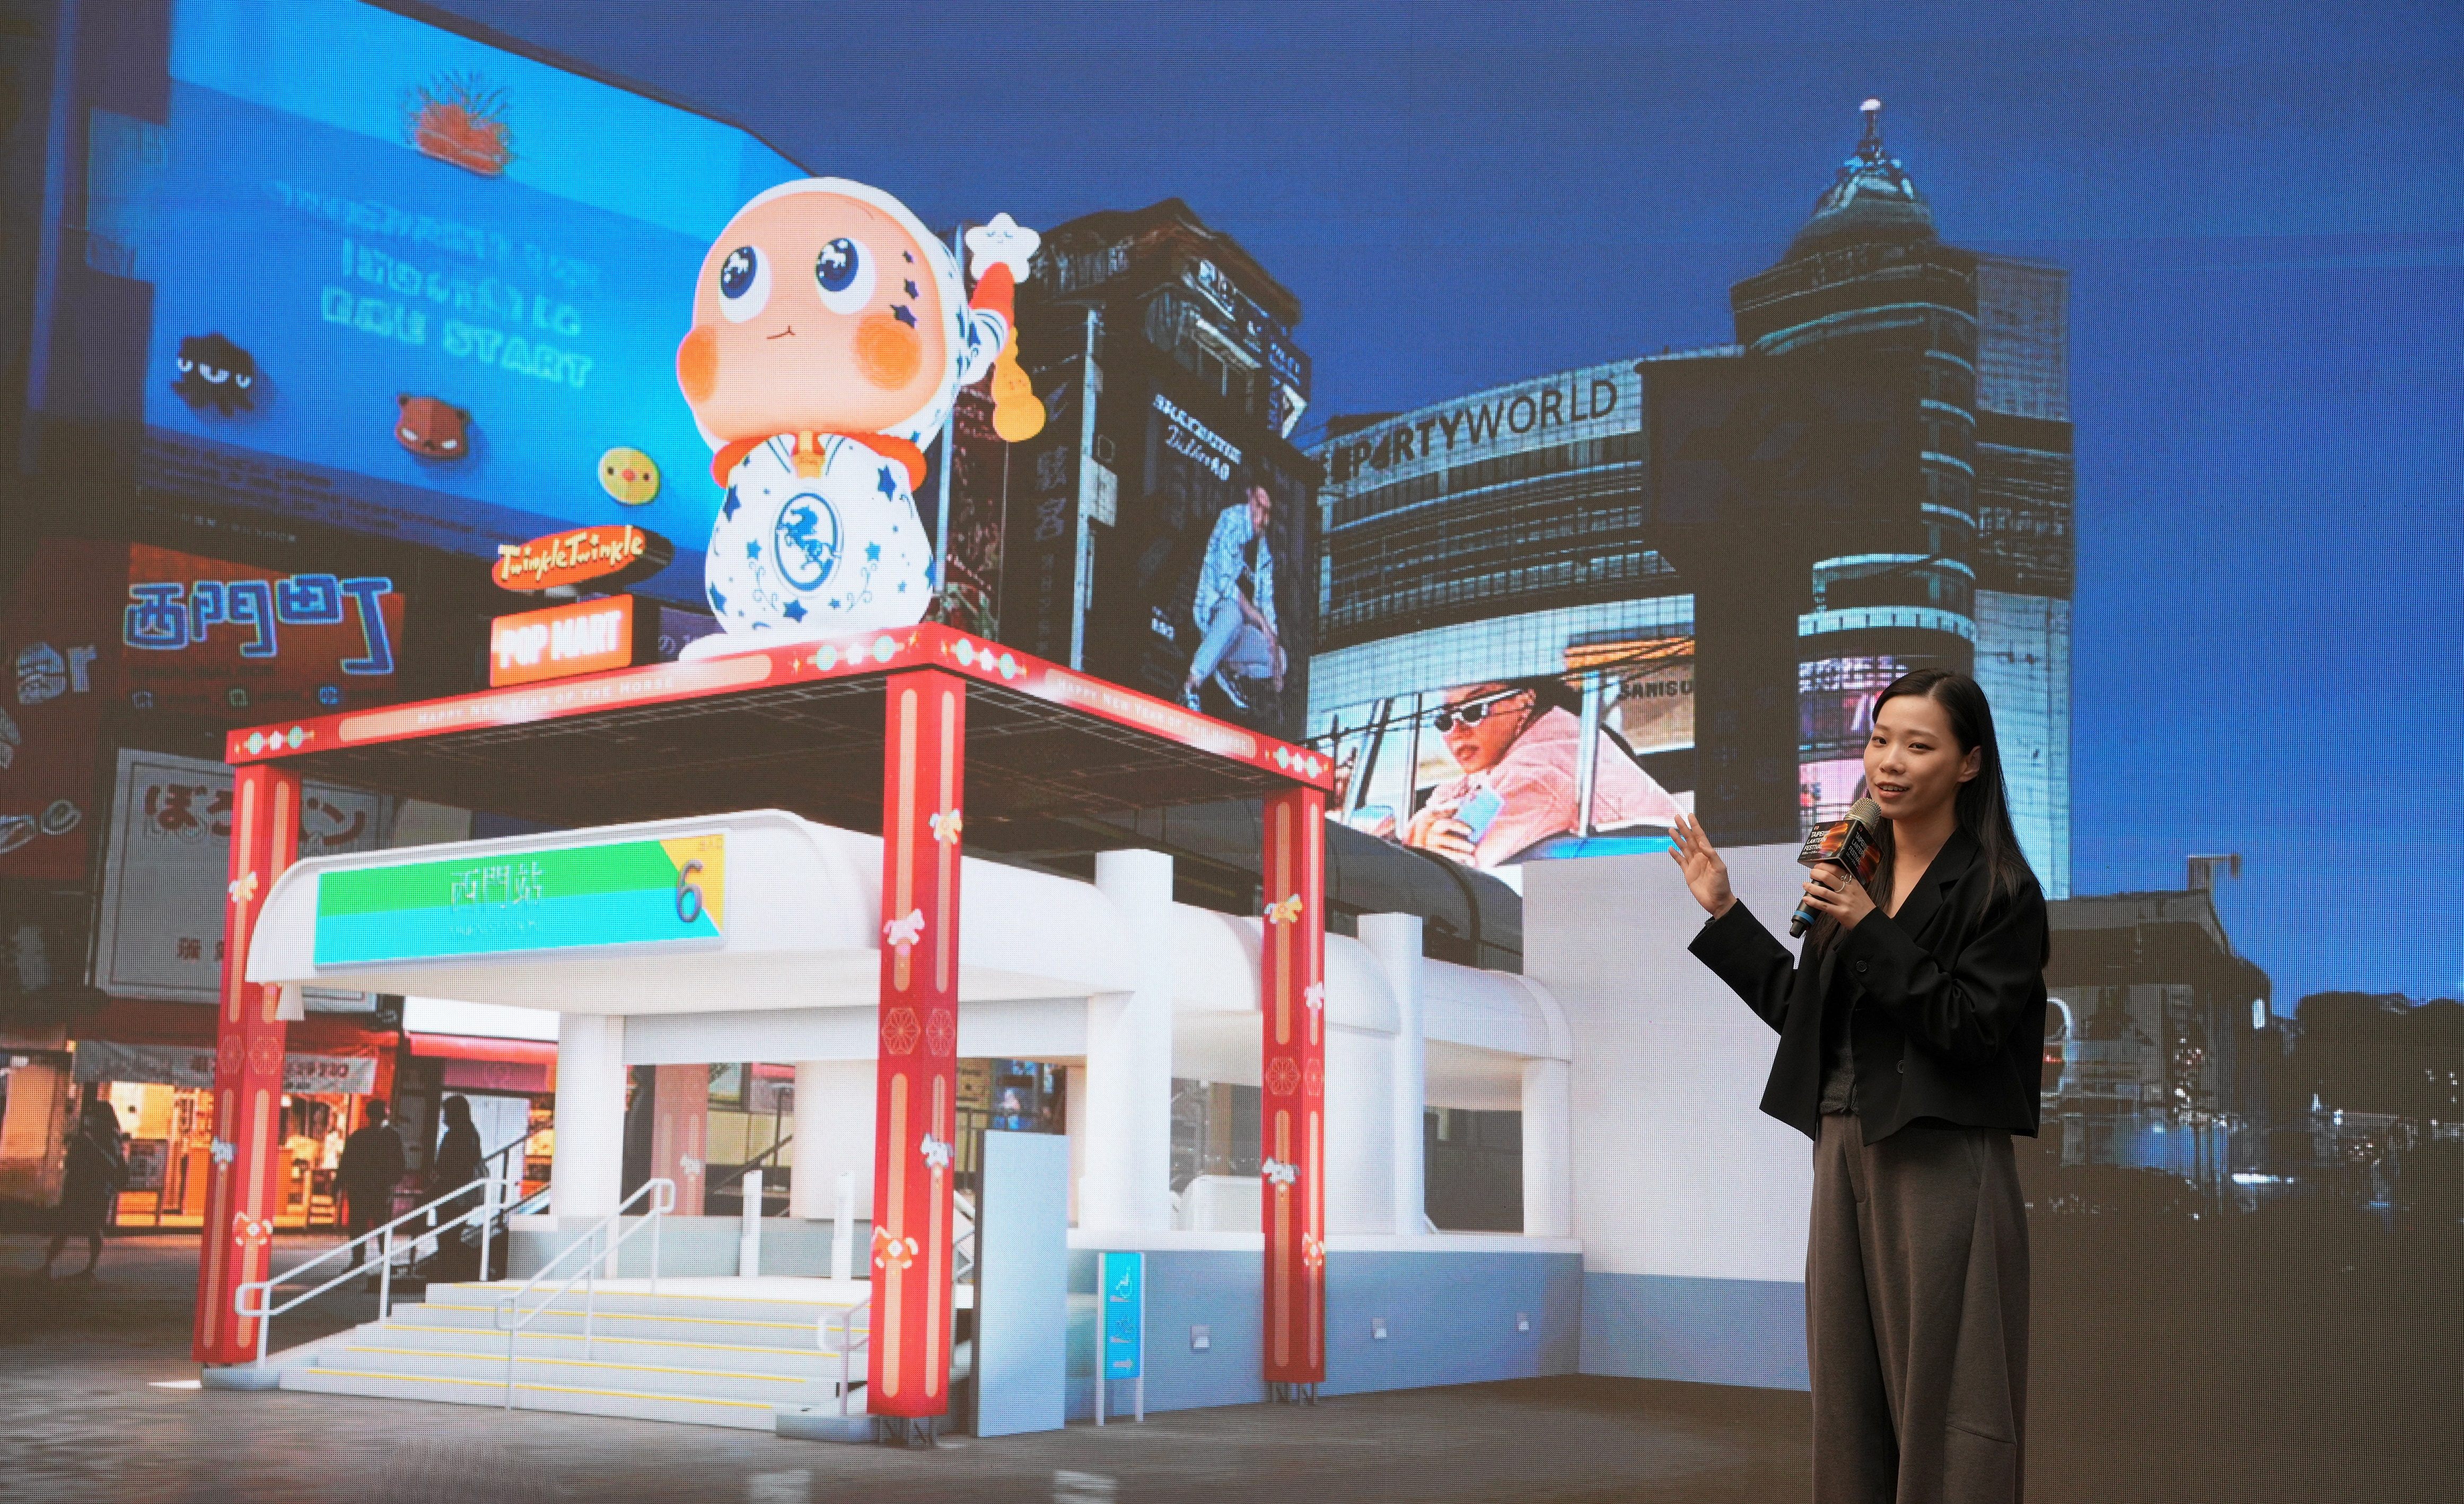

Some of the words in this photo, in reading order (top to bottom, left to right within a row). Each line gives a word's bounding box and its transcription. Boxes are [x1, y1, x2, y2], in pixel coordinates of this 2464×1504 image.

[500, 625, 548, 669] POP
[551, 610, 622, 660] MART
[676, 859, 704, 923] 6
